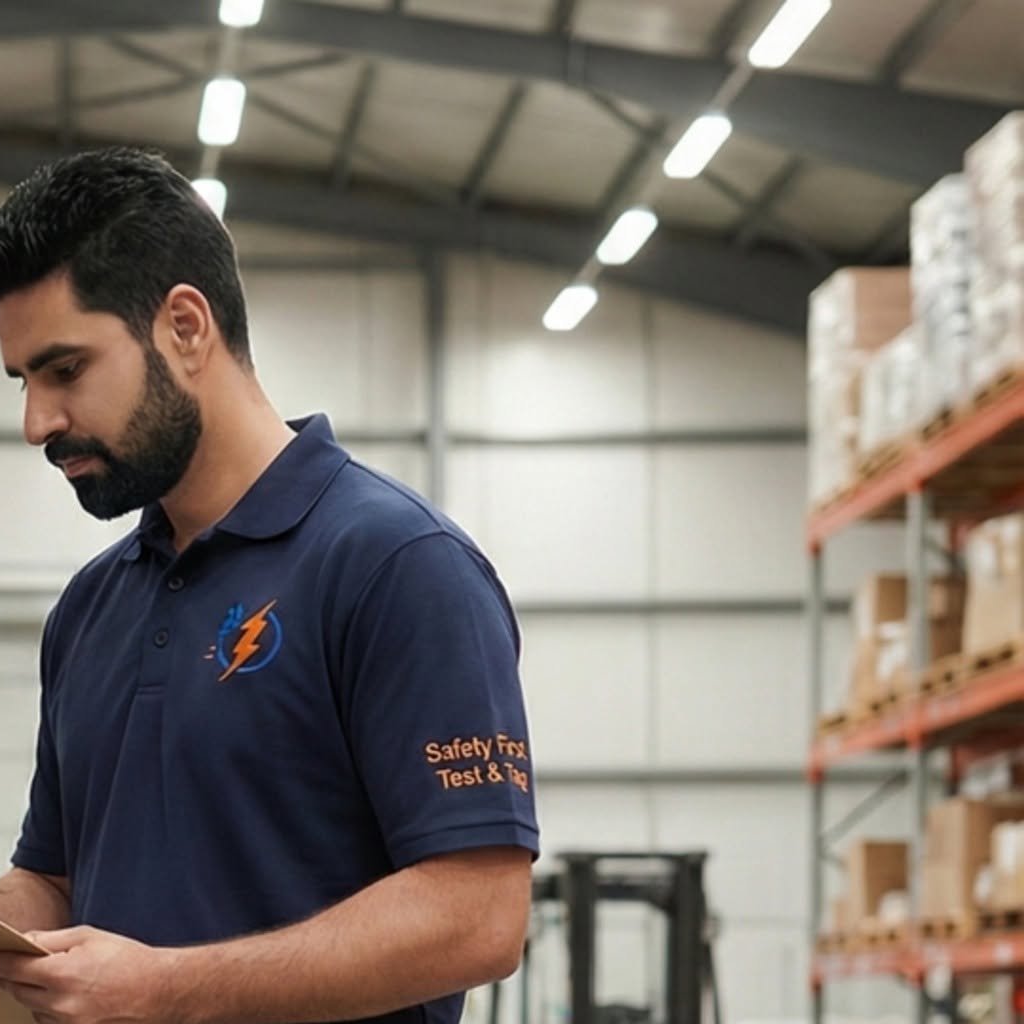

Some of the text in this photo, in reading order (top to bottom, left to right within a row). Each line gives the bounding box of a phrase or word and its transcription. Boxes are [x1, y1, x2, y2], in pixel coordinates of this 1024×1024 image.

[426, 736, 492, 763] Safety
[436, 766, 483, 789] Test
[487, 762, 505, 782] &
